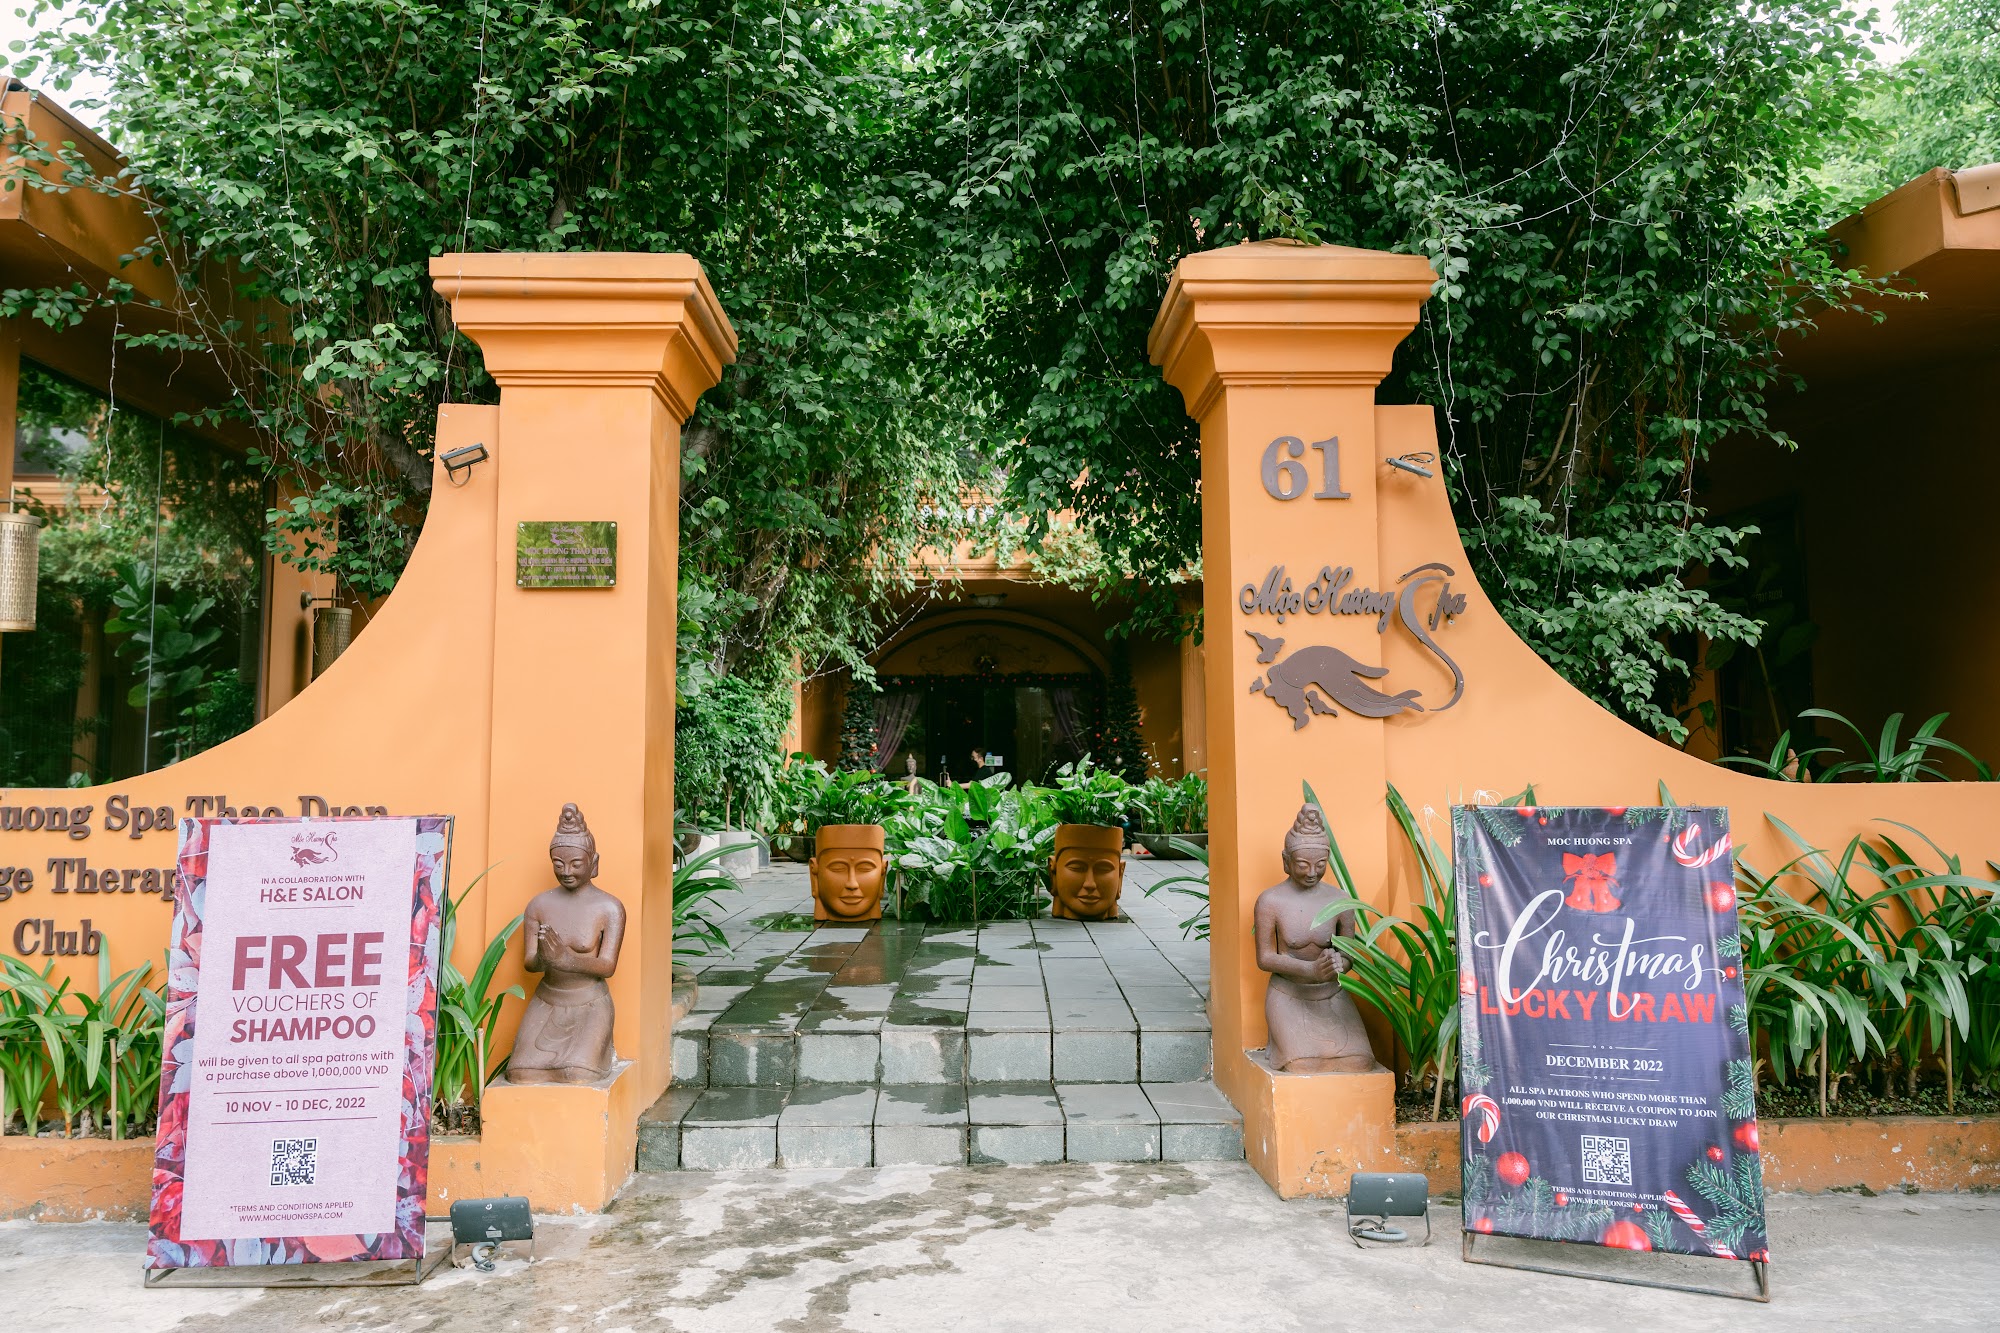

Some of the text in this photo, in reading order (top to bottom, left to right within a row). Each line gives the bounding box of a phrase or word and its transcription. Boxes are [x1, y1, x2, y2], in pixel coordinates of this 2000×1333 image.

[1261, 435, 1351, 500] 61
[0, 796, 93, 840] uong
[104, 794, 176, 839] Spa
[1547, 837, 1633, 846] MOC HUONG SPA
[261, 877, 269, 885] IN
[278, 875, 343, 884] COLLABORATION
[345, 874, 365, 882] WITH
[260, 885, 364, 903] H&E SALON
[13, 918, 103, 956] Club
[232, 931, 385, 991] FREE
[1474, 889, 1728, 1018] Christmas
[232, 991, 379, 1013] VOUCHERS OF
[1480, 985, 1717, 1024] LUCKY DRAW
[230, 1014, 376, 1043] SHAMPOO
[198, 1050, 394, 1069] will be given to all spa patrons with
[1546, 1054, 1664, 1072] DECEMBER 2022
[205, 1065, 389, 1083] a purchase above 1,000,000 VND
[1509, 1085, 1707, 1105] ALL SPA PATRONS WHO SPEND MORE THAN
[226, 1101, 239, 1113] 10
[242, 1100, 272, 1113] NOV
[285, 1099, 299, 1111] 10
[302, 1098, 332, 1111] DEC,
[335, 1096, 366, 1109] 2022
[1501, 1096, 1717, 1118] 1,000,000 VND WILL RECEIVE A COUPON TO JOIN
[1535, 1111, 1678, 1128] OUR CHRISTMAS LUCKY DRAW
[1562, 1195, 1659, 1211] WWW.MOCHUONGSPA.COM
[1592, 1189, 1637, 1200] CONDITIONS
[259, 1204, 276, 1212] AND
[276, 1202, 323, 1211] CONDITIONS
[324, 1201, 354, 1210] APPLIED
[239, 1211, 343, 1222] WWW.MOCHUONGSPA.COM
